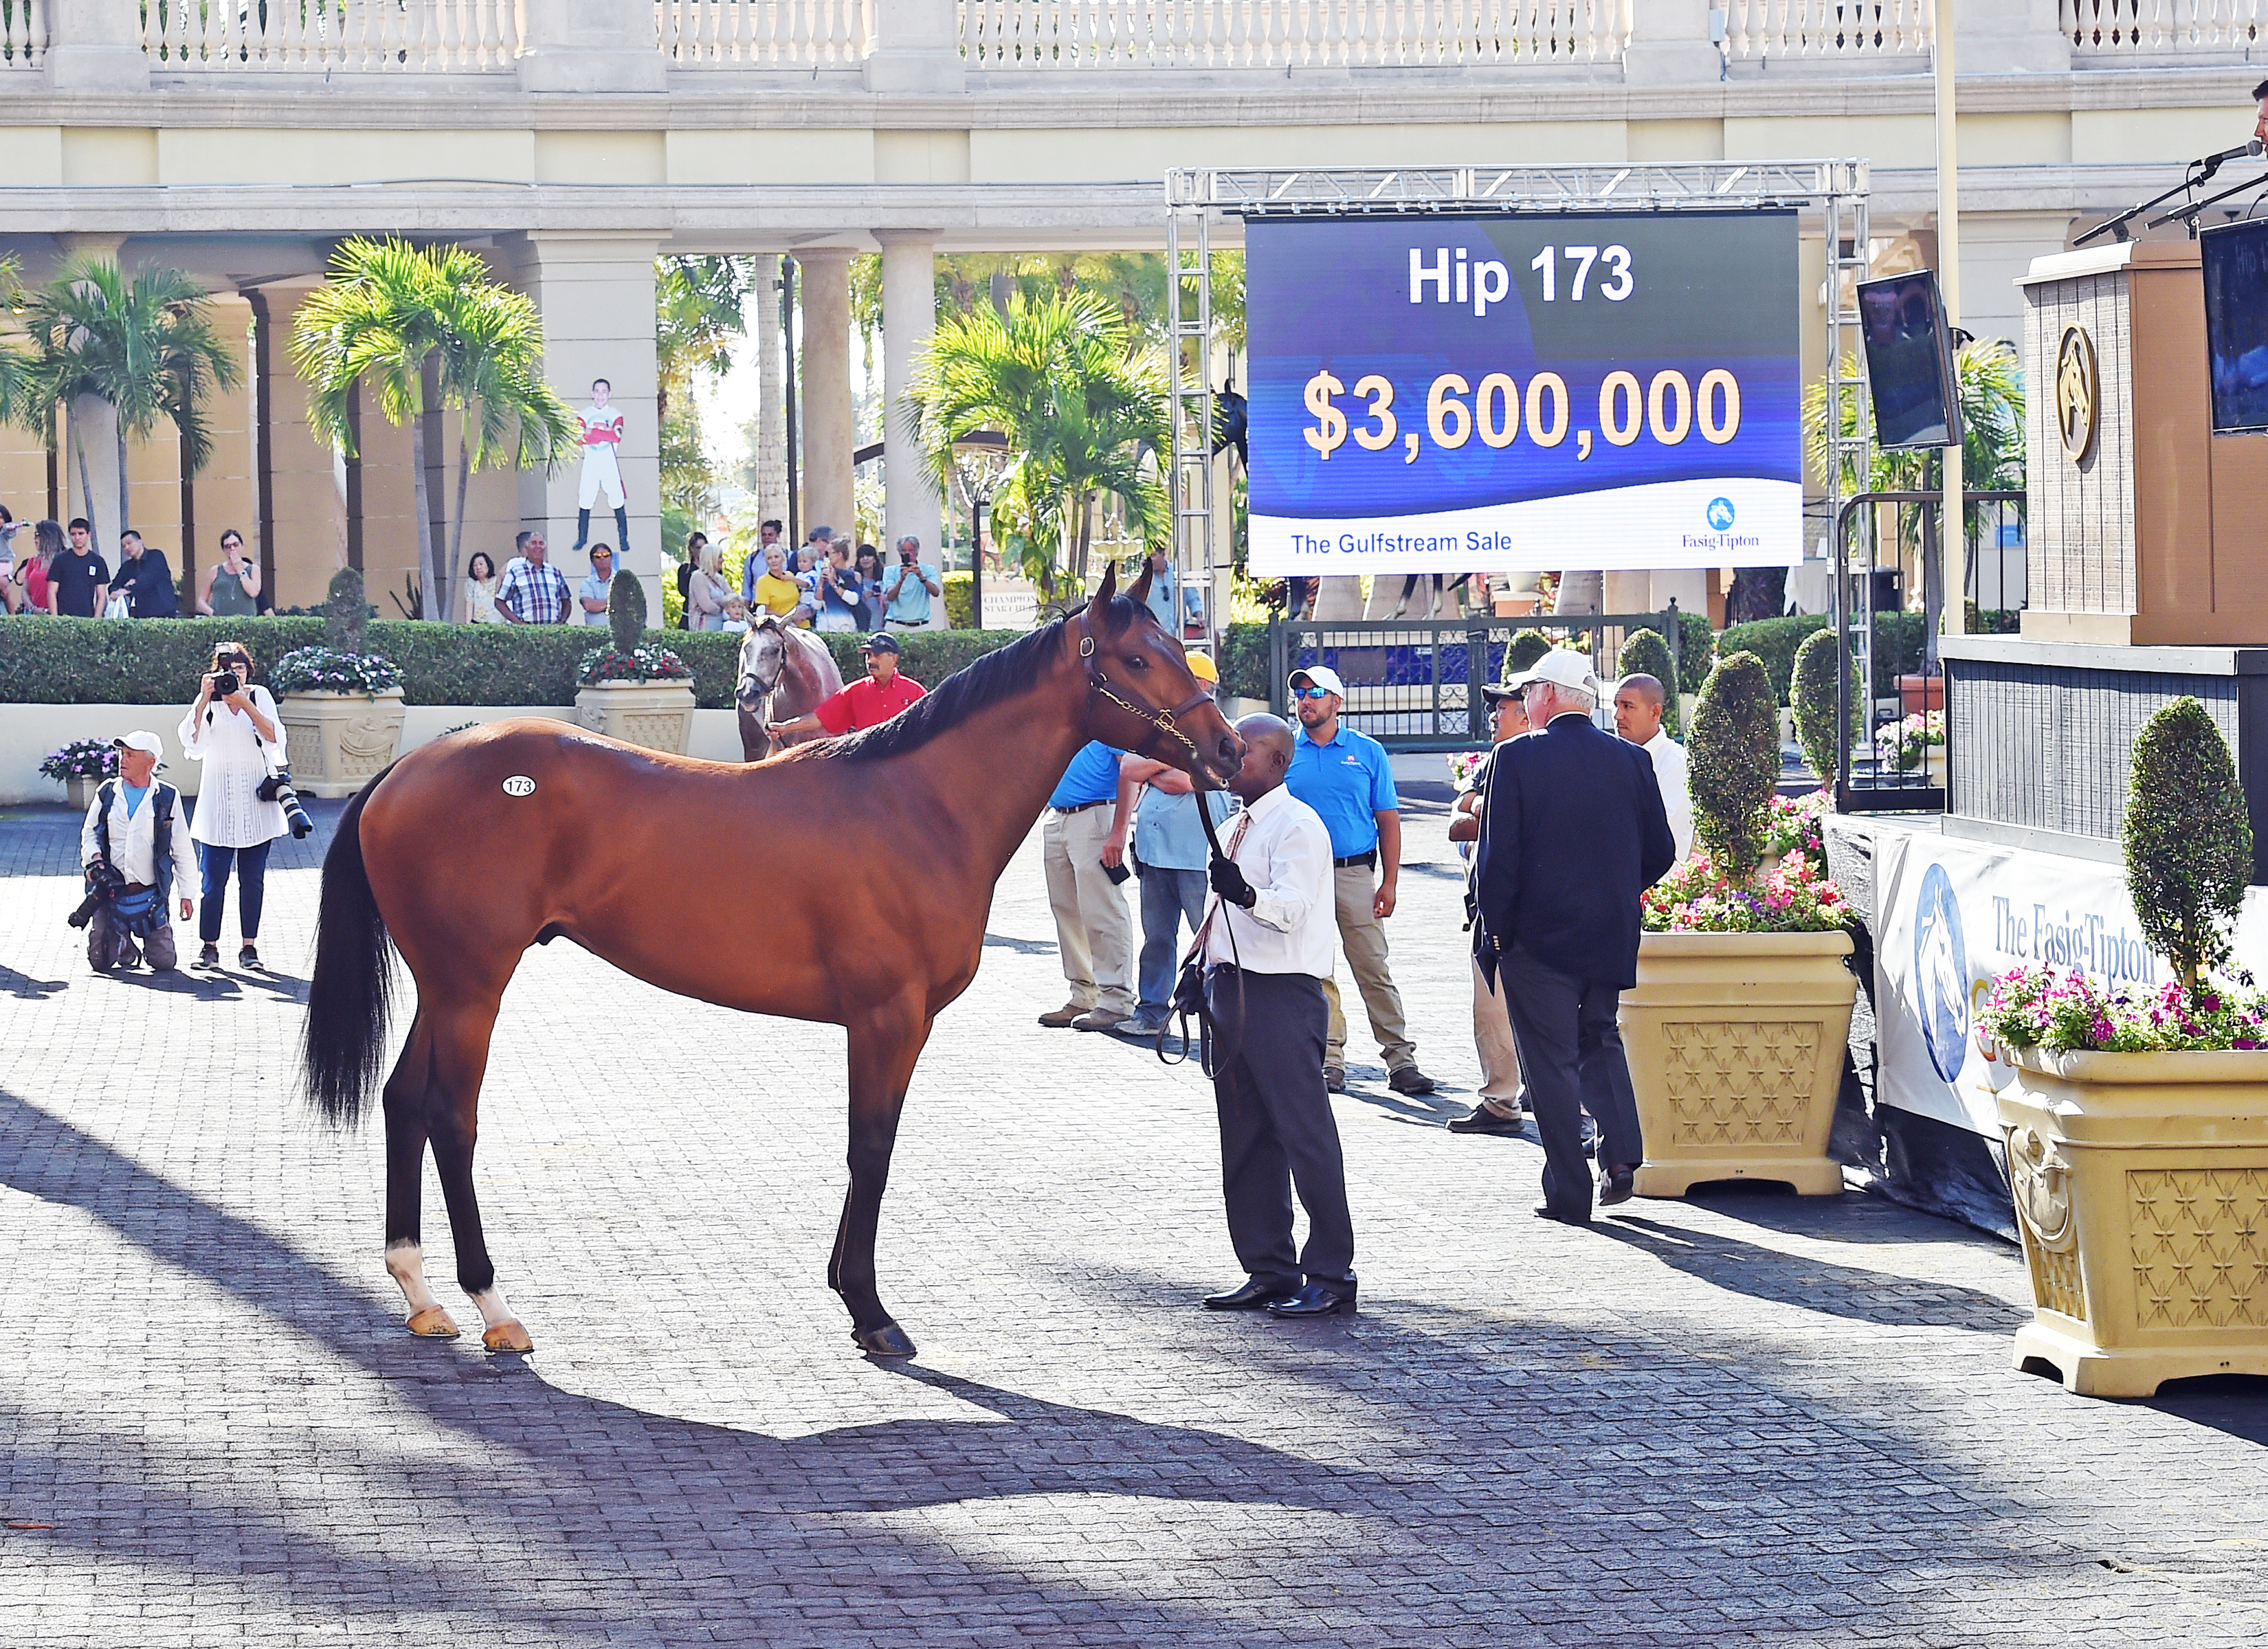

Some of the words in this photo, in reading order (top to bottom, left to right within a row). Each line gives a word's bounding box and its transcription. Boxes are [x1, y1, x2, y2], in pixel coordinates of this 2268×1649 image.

[1409, 247, 1511, 317] Hip
[1531, 244, 1634, 302] 173
[1302, 368, 1742, 464] $3,600,000
[1291, 535, 1331, 554] The
[1339, 533, 1458, 553] Gulfstream
[1466, 531, 1512, 551] Sale
[1682, 534, 1759, 551] Fasig-Tipton
[507, 781, 531, 792] 173
[1992, 895, 2027, 958] The
[2033, 904, 2156, 994] Fasig-Tipton
